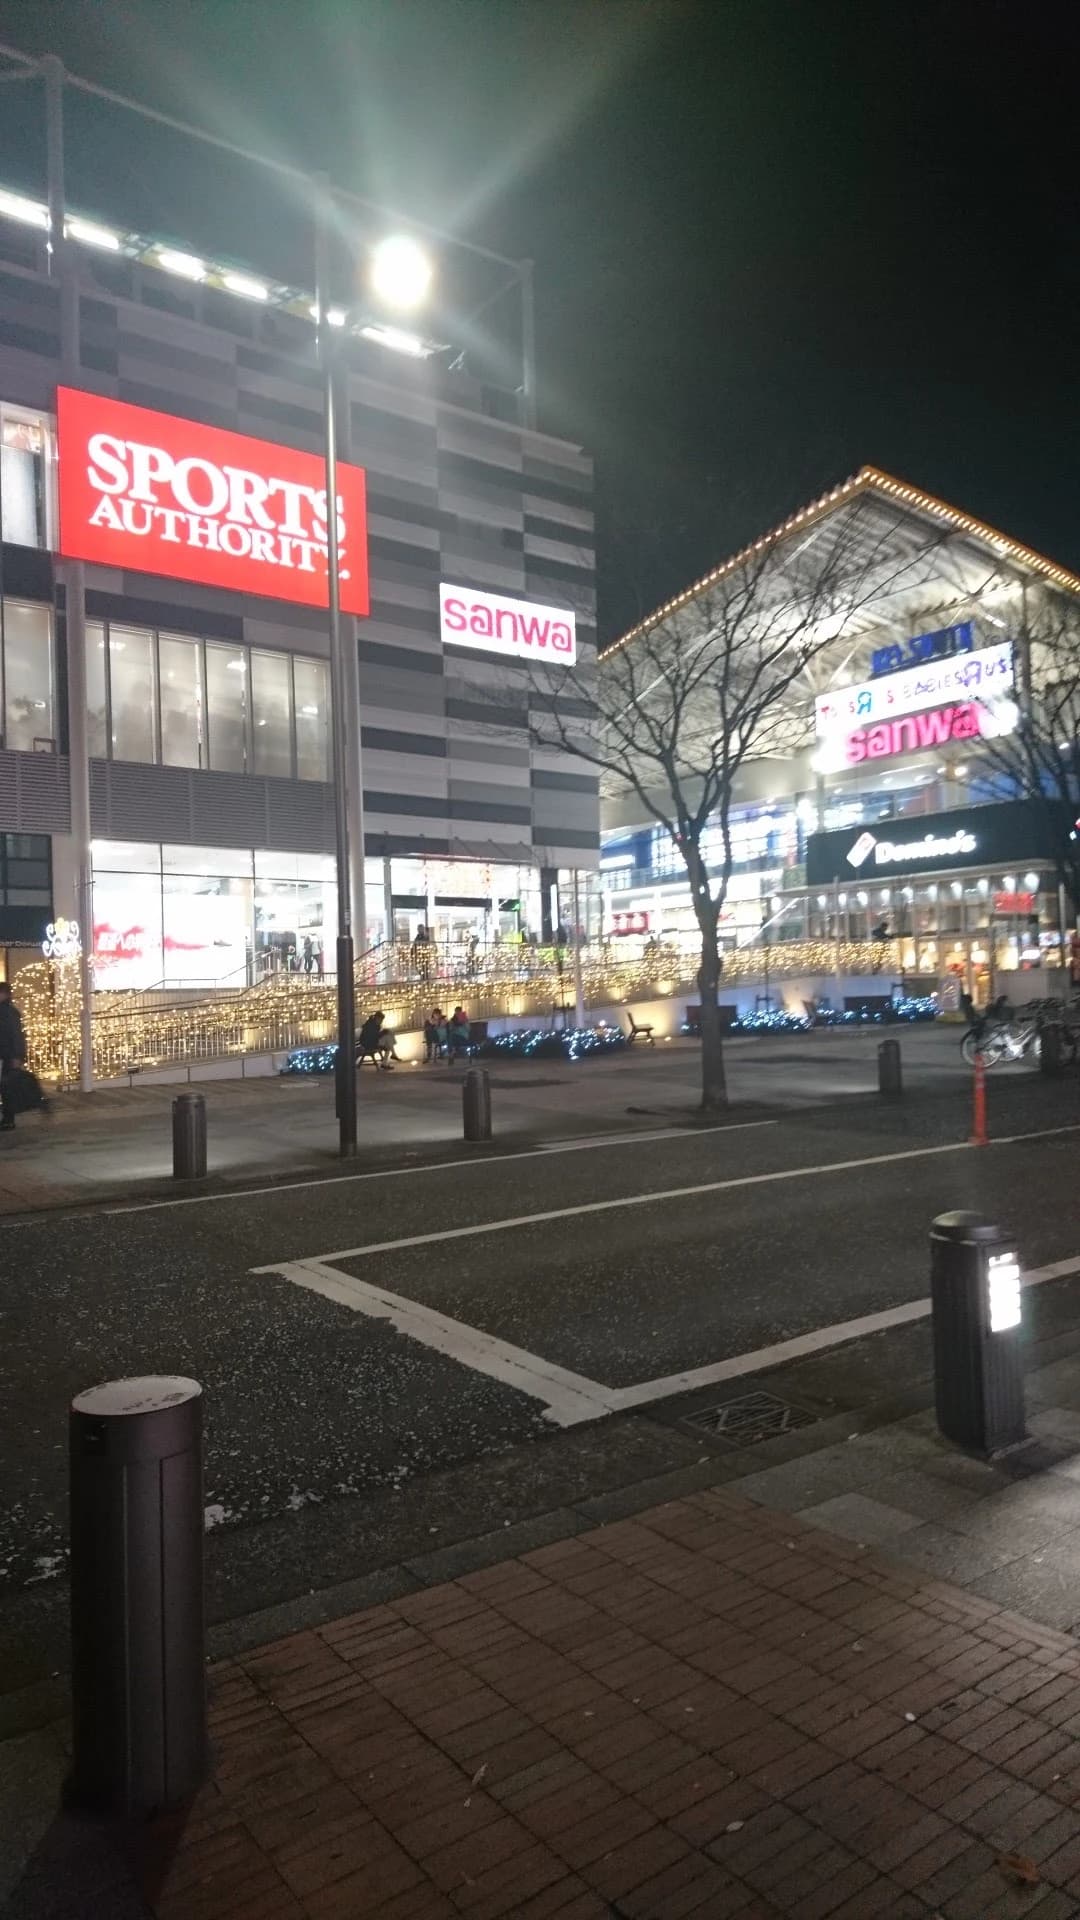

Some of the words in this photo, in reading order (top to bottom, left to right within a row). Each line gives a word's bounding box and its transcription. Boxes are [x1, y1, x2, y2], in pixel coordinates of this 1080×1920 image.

[87, 433, 346, 544] SPORTS
[444, 598, 572, 653] sanwa
[846, 702, 982, 763] sanwa
